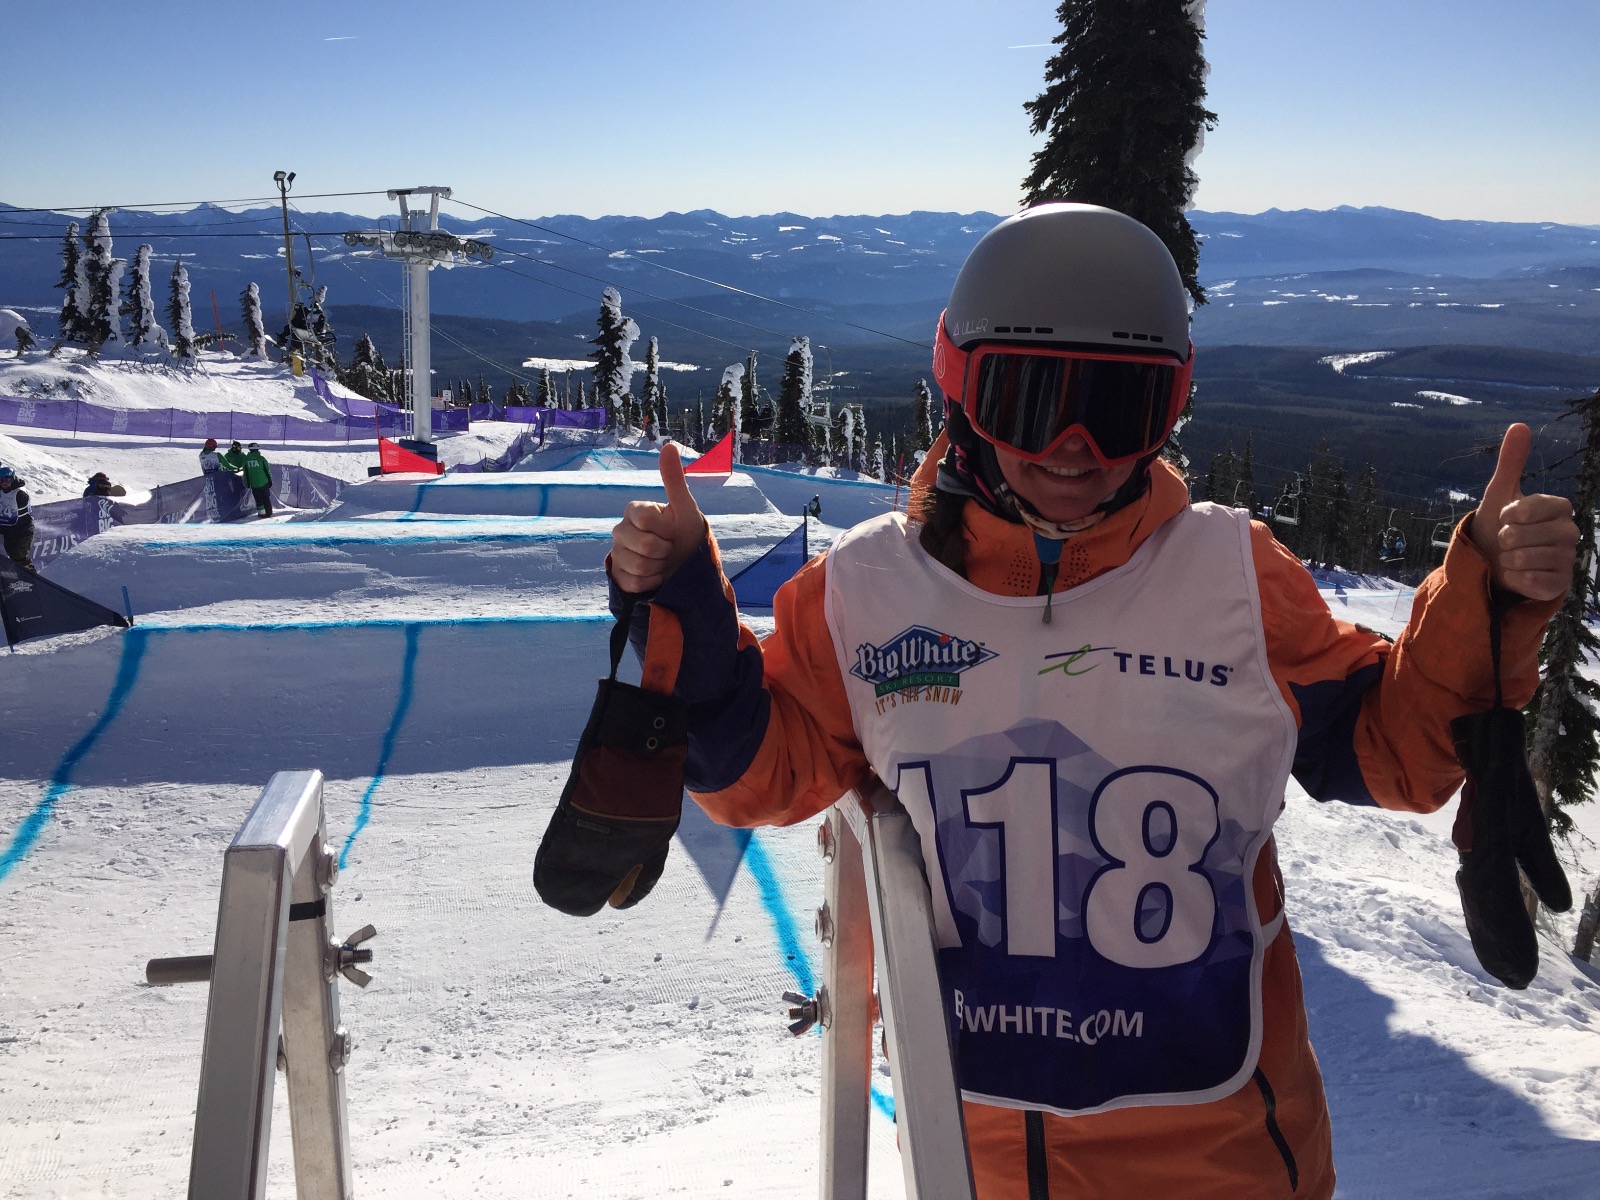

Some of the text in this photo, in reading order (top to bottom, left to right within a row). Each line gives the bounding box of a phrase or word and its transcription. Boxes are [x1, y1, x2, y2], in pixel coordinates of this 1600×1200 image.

[18, 407, 36, 418] BIG
[32, 534, 79, 559] TELUS
[1113, 651, 1228, 687] TELUS
[879, 673, 955, 693] SKI RESORT
[875, 692, 897, 716] IT'S
[926, 685, 964, 706] SNOW
